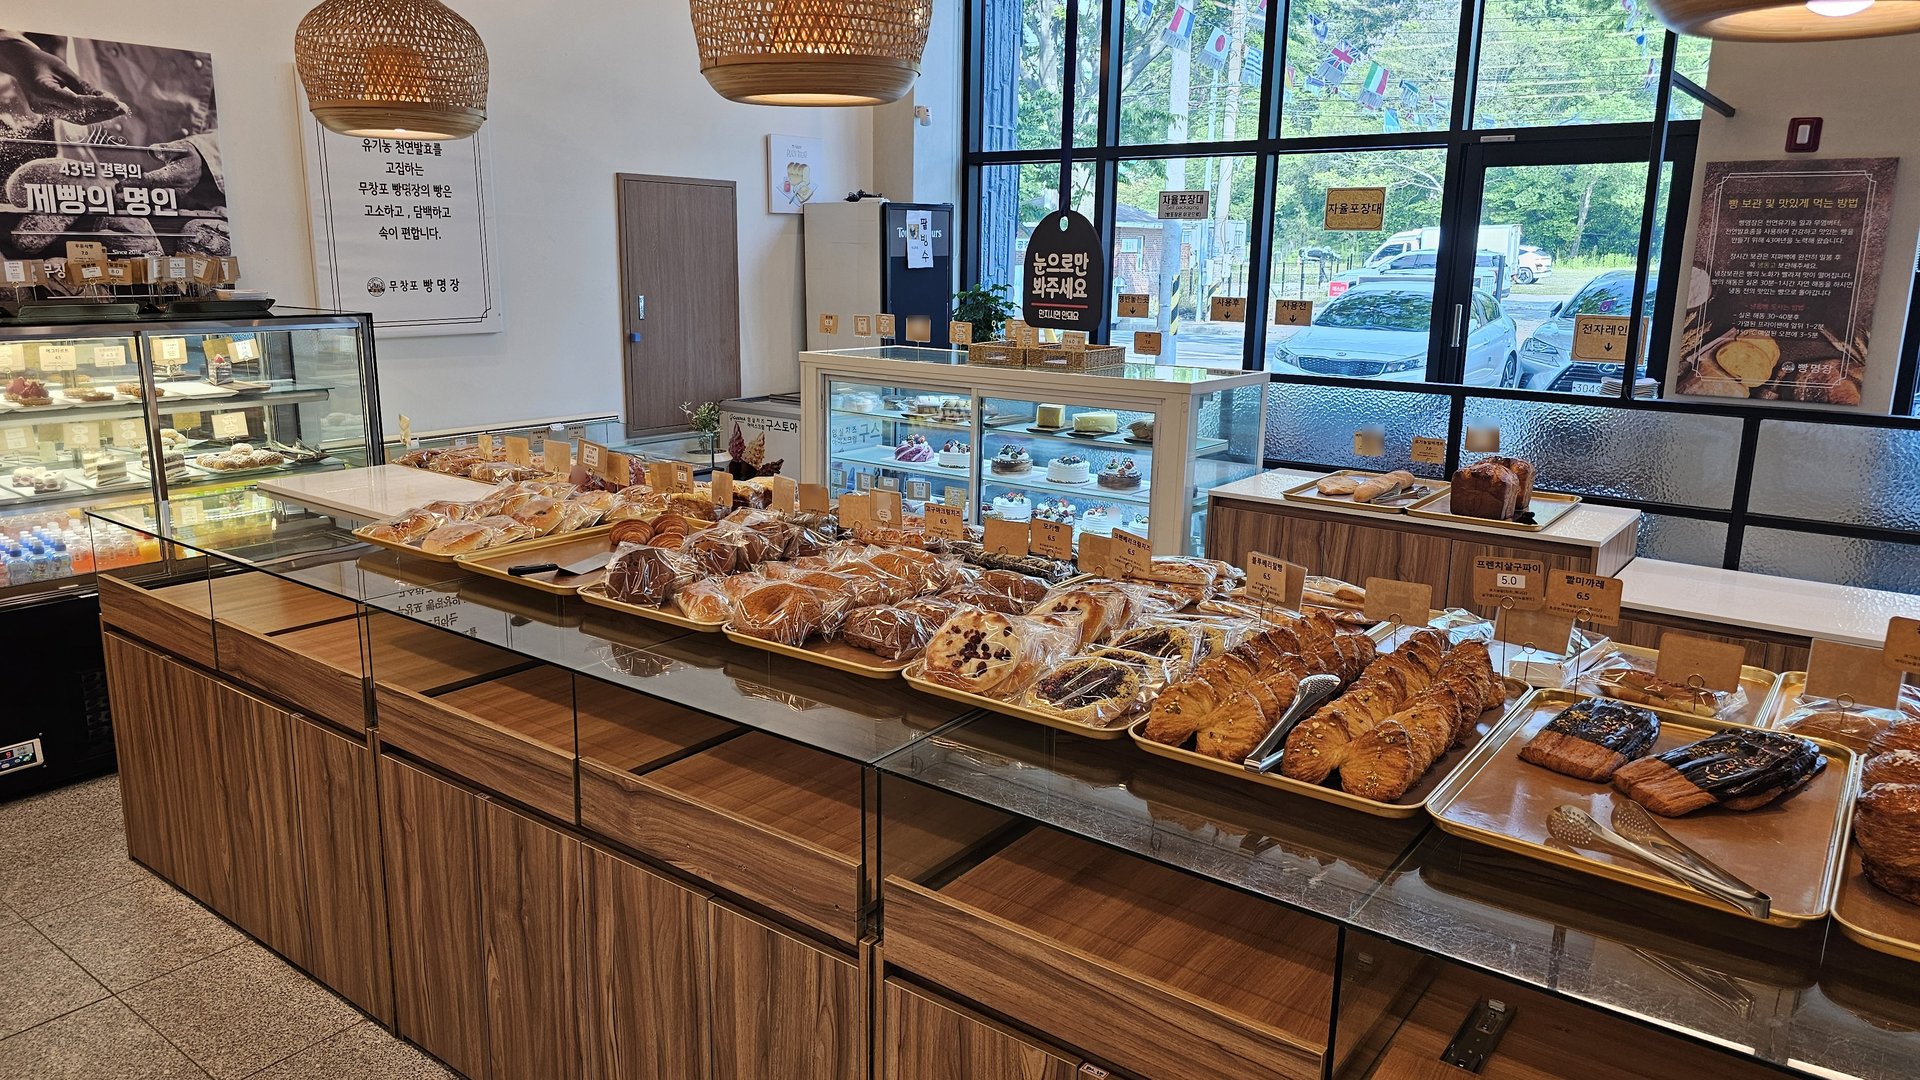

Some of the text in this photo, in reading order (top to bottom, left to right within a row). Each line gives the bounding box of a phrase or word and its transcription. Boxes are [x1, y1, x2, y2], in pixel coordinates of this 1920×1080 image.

[362, 138, 442, 156] 유기농 천연발효를
[59, 162, 142, 178] 43년 경력의
[386, 162, 424, 176] 고집하는
[358, 182, 452, 198] 무창포 빵명장의 빵은
[24, 183, 178, 217] 제빵의 명인
[1162, 194, 1204, 204] 자율포장대
[1728, 198, 1858, 209] 빵 보관 및 맛있게 먹는 방법
[364, 204, 404, 218] 고소하고
[414, 205, 452, 218] 담백하고
[1328, 203, 1382, 214] 자율포장대
[378, 226, 442, 240] 속이 편합니다.
[44, 262, 66, 278] 무창
[1033, 252, 1090, 276] 눈으로만
[389, 280, 418, 292] 무창포
[423, 278, 460, 293] 빵명장
[1032, 276, 1088, 300] 봐주세요
[1216, 298, 1240, 308] 사용후
[1282, 302, 1306, 310] 사용전
[1038, 308, 1060, 320] 만지시면
[1582, 324, 1628, 336] 전자레인
[1798, 364, 1832, 374] 빵명장
[766, 420, 798, 433] 구스토아
[859, 422, 880, 442] 구스
[1476, 560, 1540, 574] 프렌치살구파이
[1501, 576, 1517, 586] 5.0
[1566, 575, 1604, 590] 빨미까레
[1576, 592, 1590, 600] 6.5
